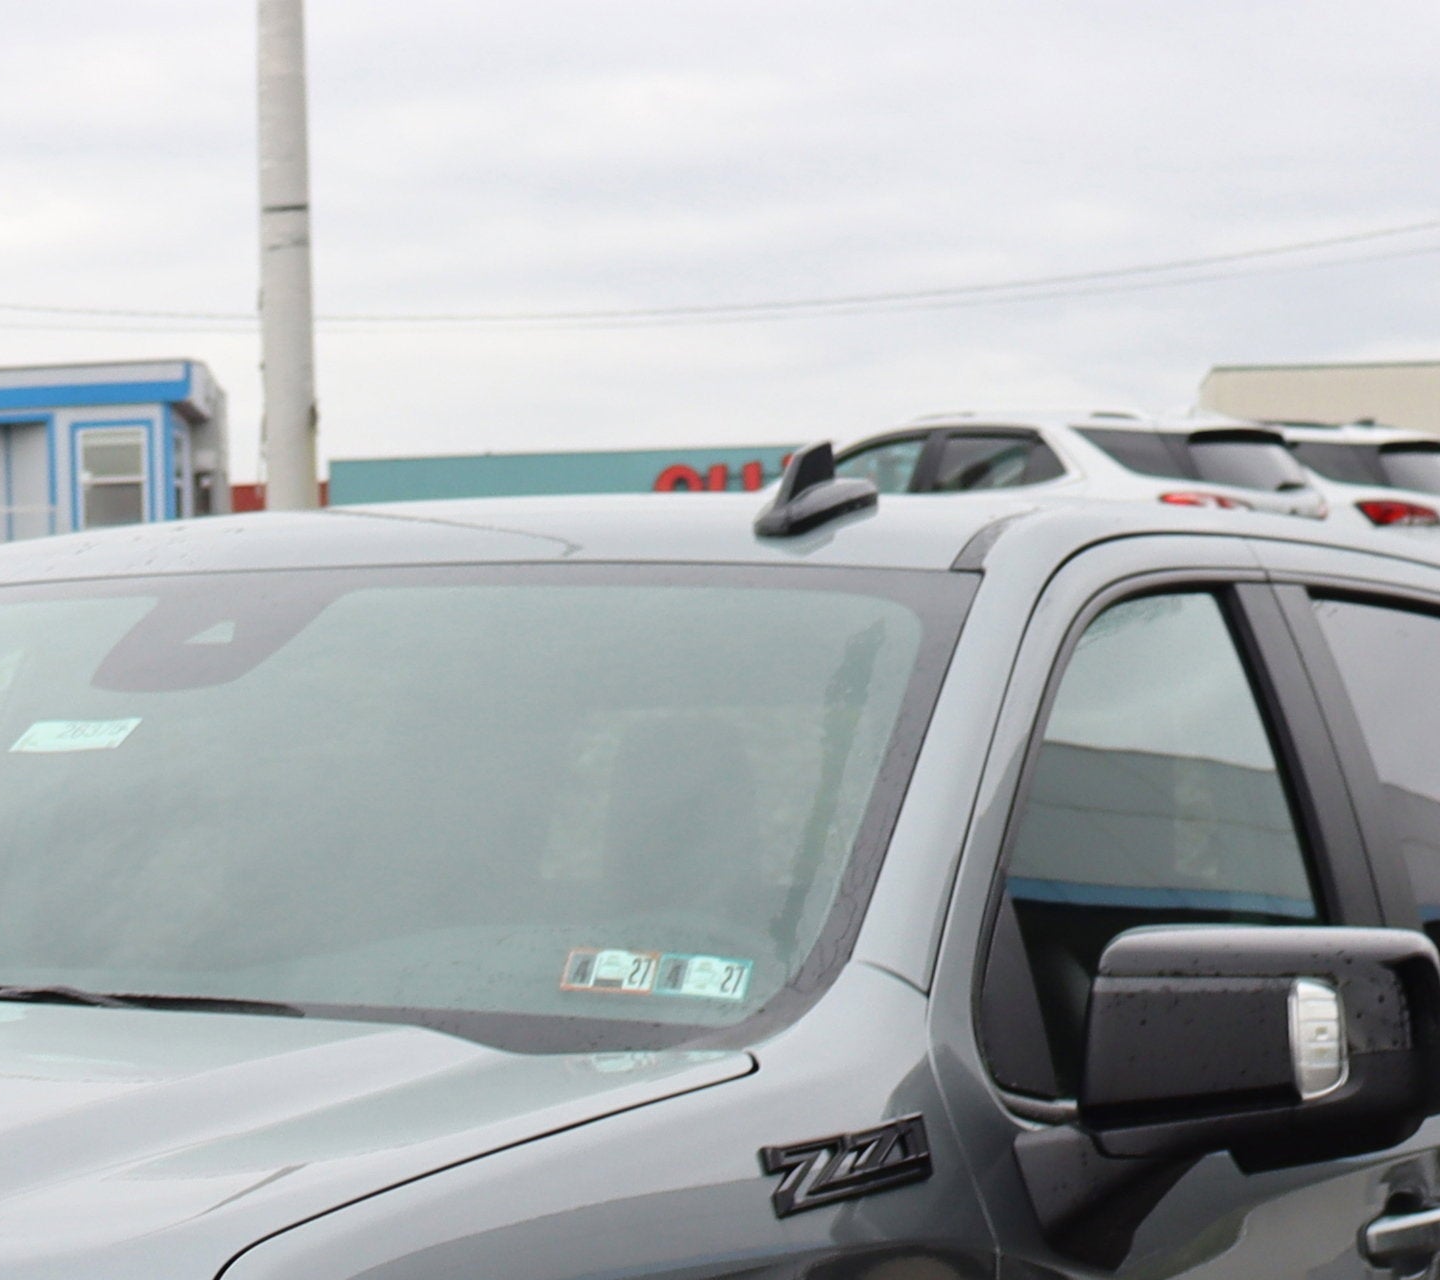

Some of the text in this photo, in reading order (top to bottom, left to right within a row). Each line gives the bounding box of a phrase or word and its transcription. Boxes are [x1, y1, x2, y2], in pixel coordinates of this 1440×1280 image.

[628, 957, 655, 986] 27
[720, 965, 746, 994] 27
[758, 1112, 933, 1219] Z71
